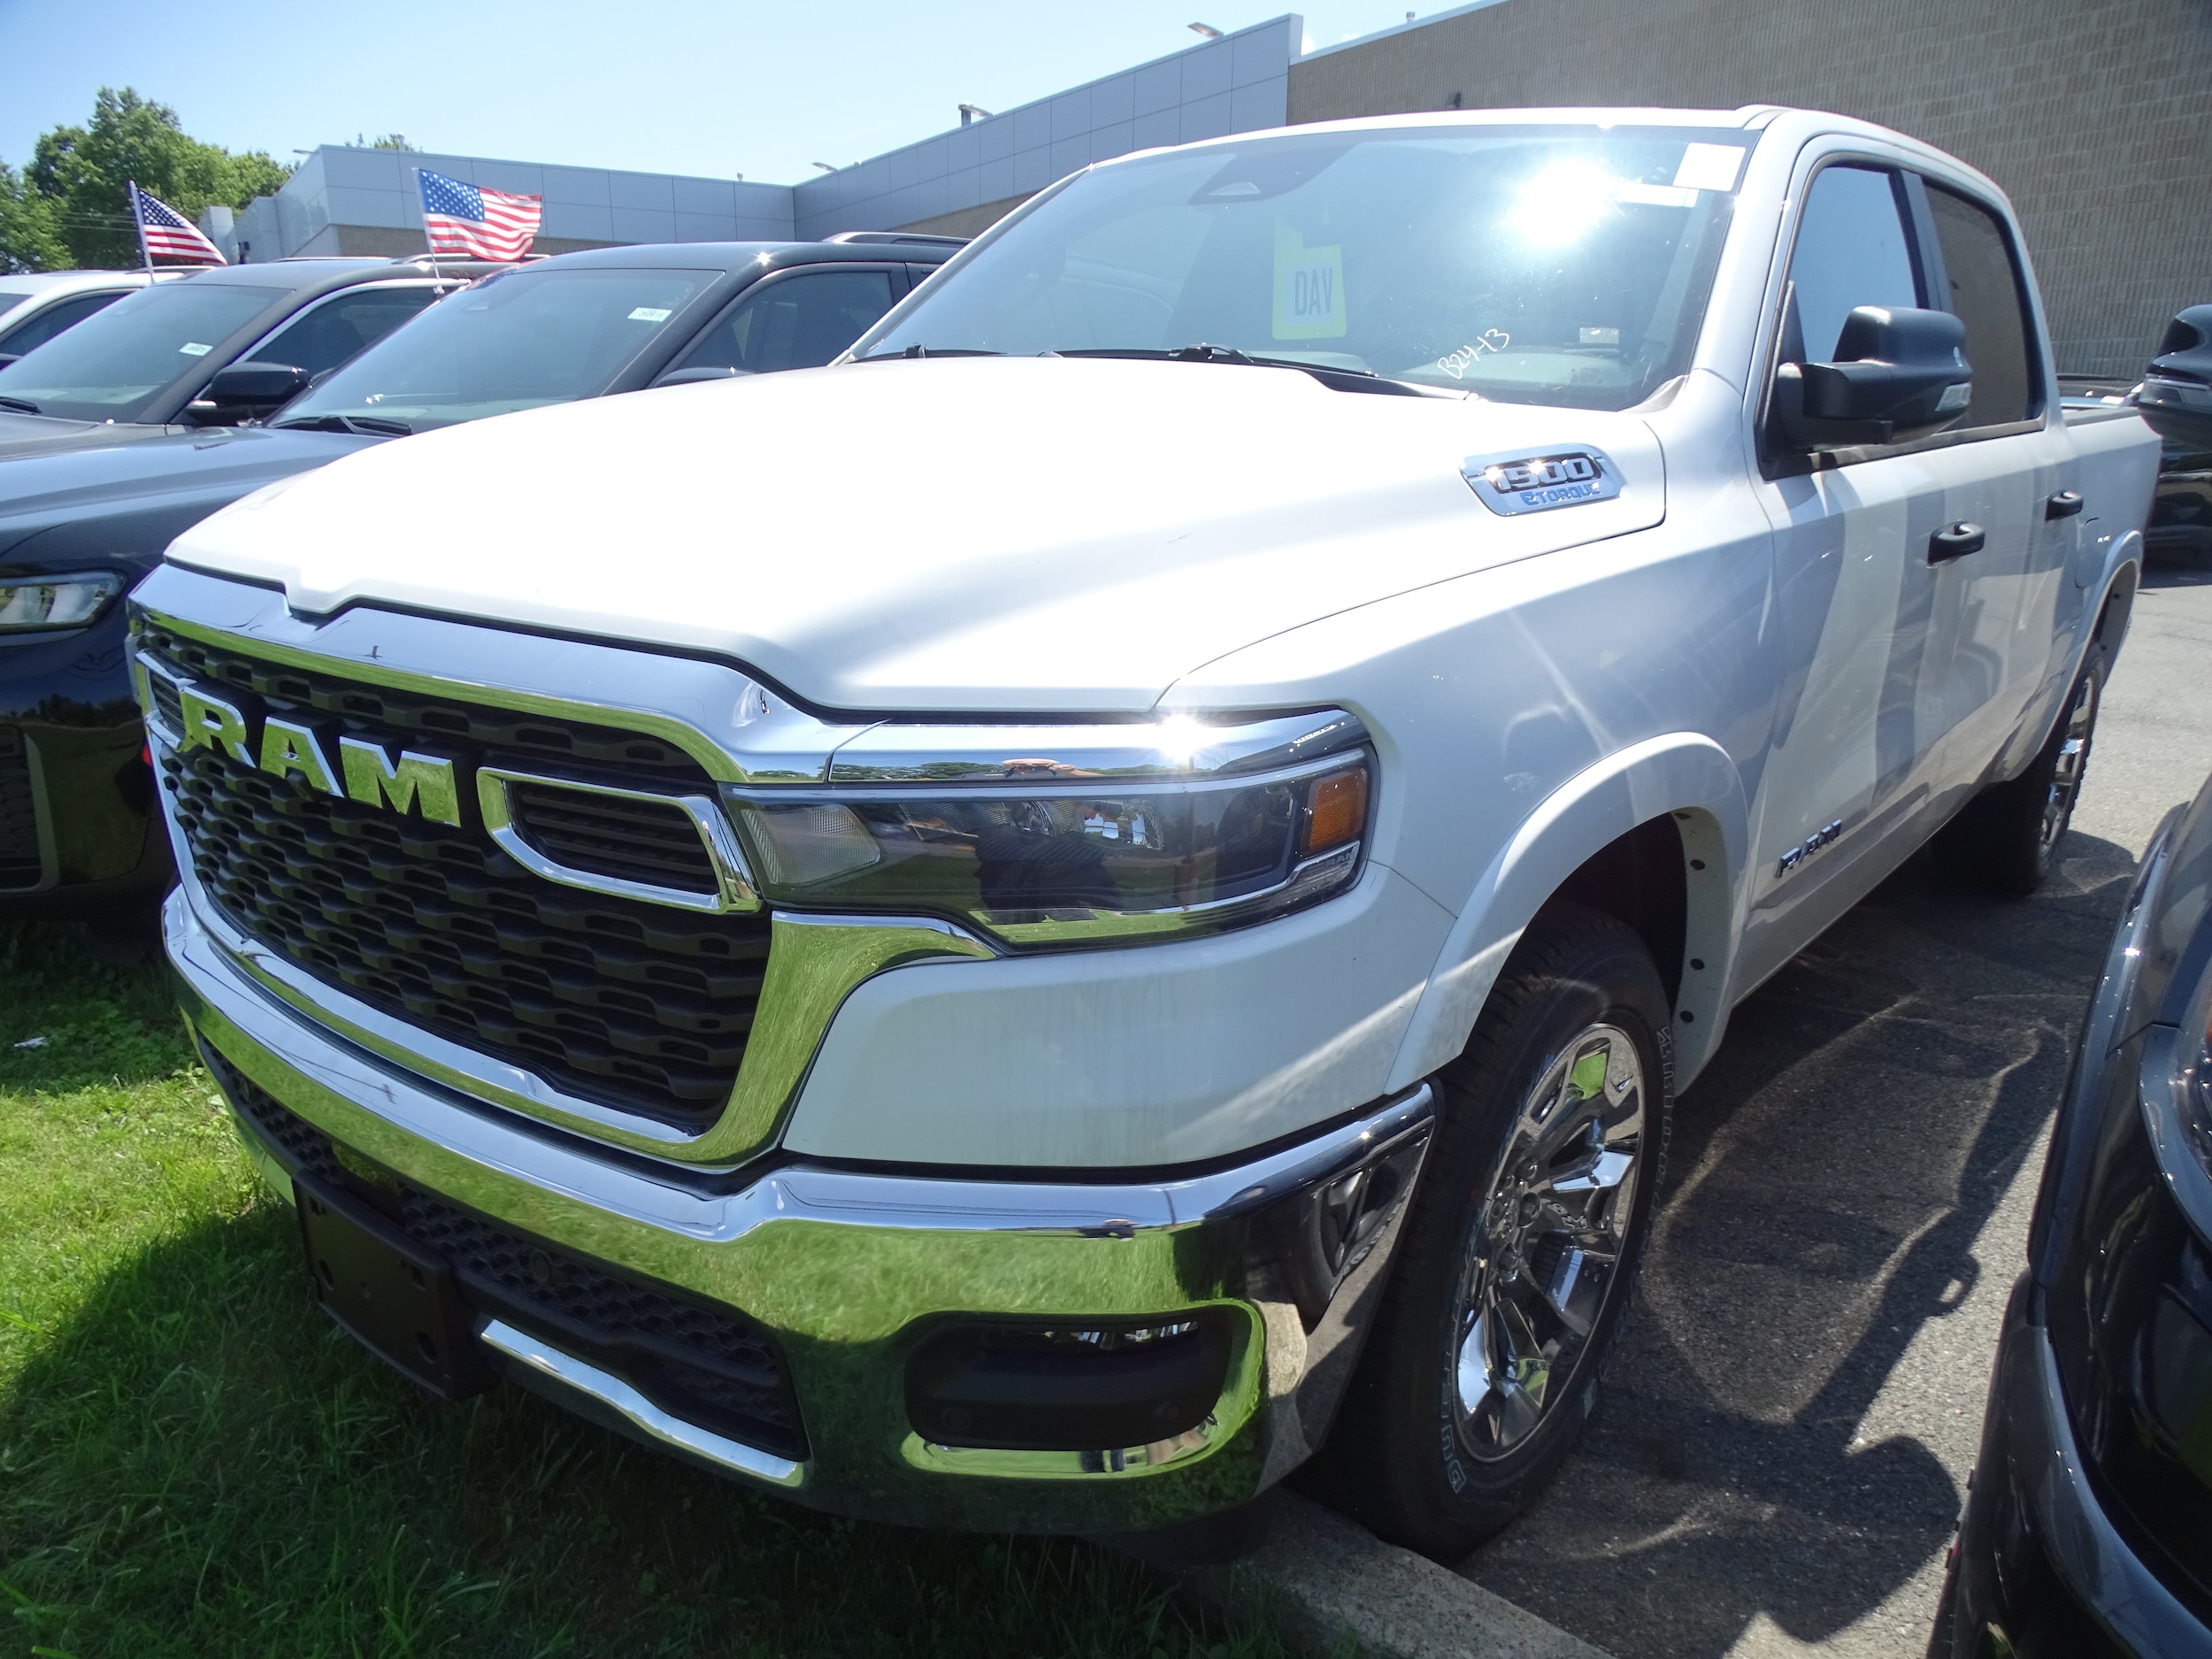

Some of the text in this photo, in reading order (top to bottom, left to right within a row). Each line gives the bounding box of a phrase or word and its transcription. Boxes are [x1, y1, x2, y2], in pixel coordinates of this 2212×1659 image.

[1294, 267, 1333, 317] DAV
[1437, 328, 1509, 380] B24-13
[1486, 457, 1594, 492] 1500
[179, 685, 461, 828] RAM
[1774, 818, 1842, 879] RAM
